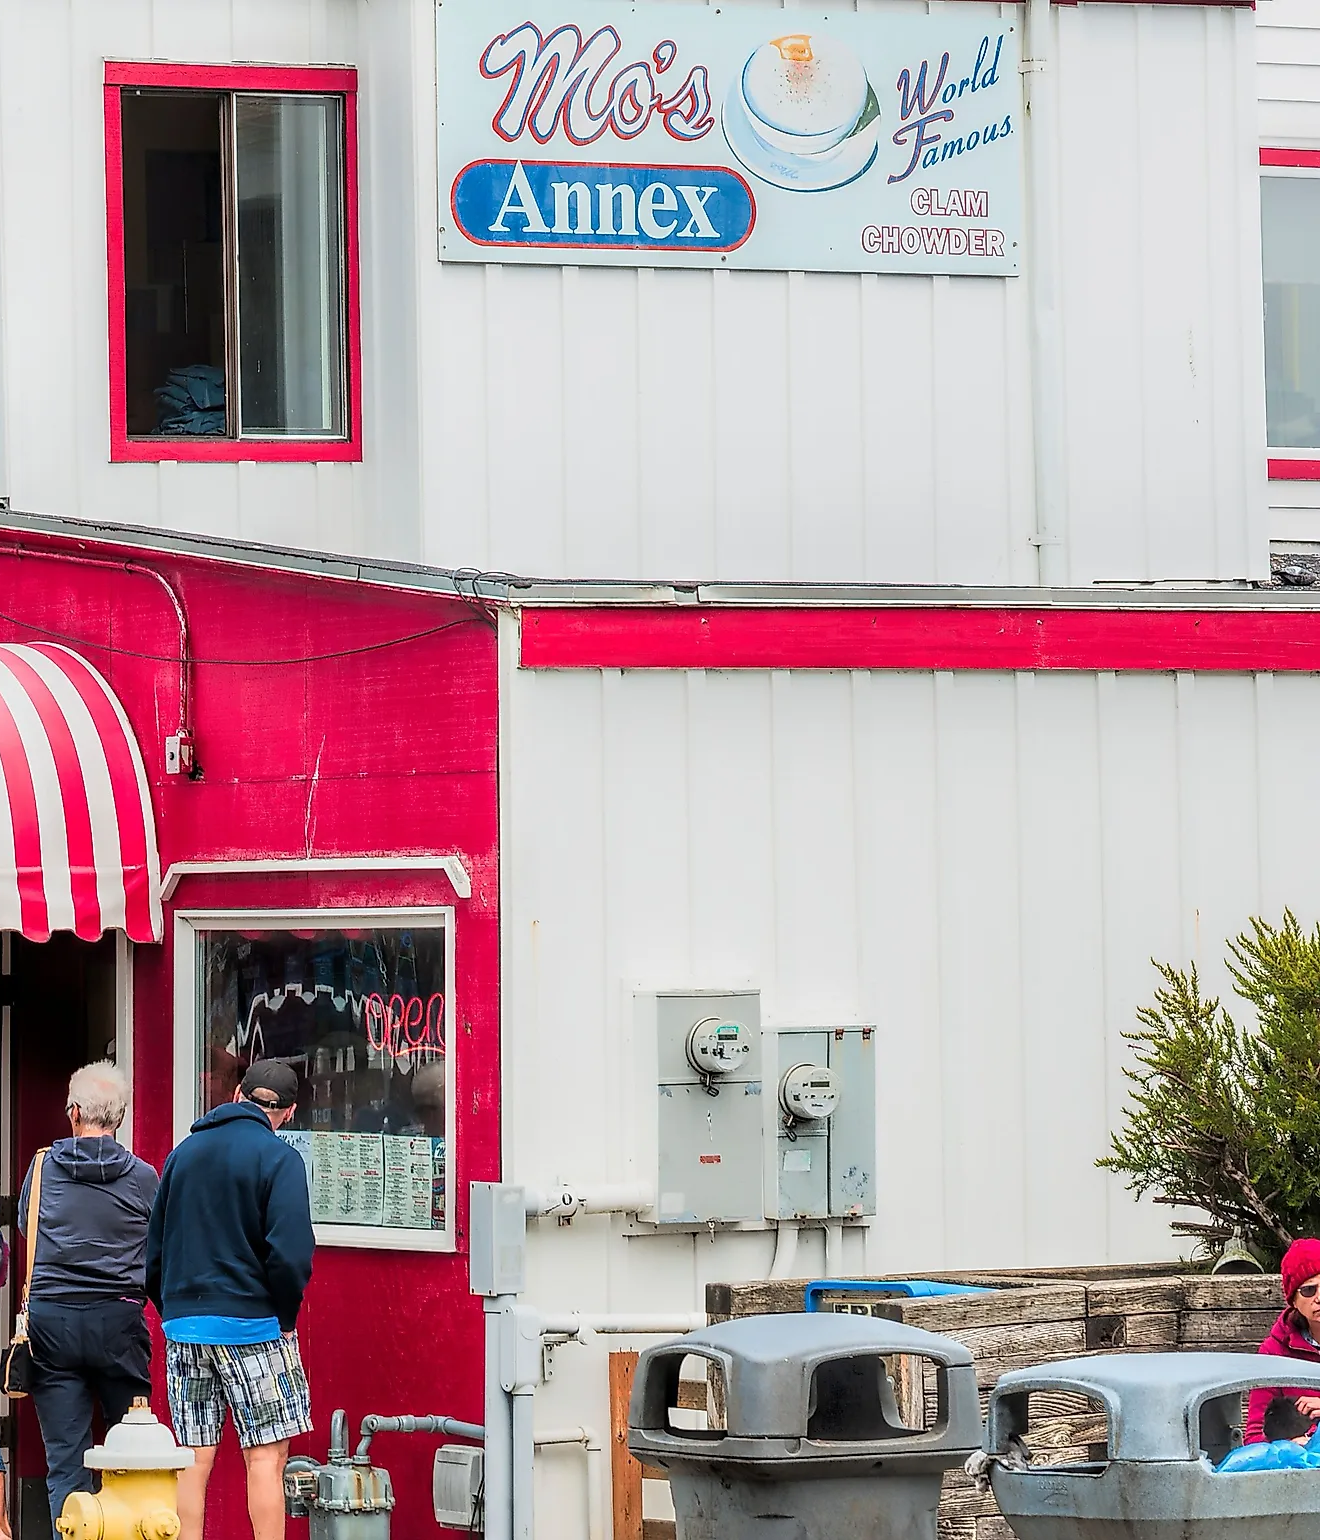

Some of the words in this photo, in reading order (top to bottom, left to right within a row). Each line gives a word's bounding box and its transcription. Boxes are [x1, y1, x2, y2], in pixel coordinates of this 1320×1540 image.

[479, 20, 715, 145] Mo's
[896, 35, 1003, 121] World
[887, 109, 1012, 184] Famous
[487, 159, 722, 240] Annex
[910, 187, 988, 217] CLAM
[861, 225, 1005, 257] CHOWDER
